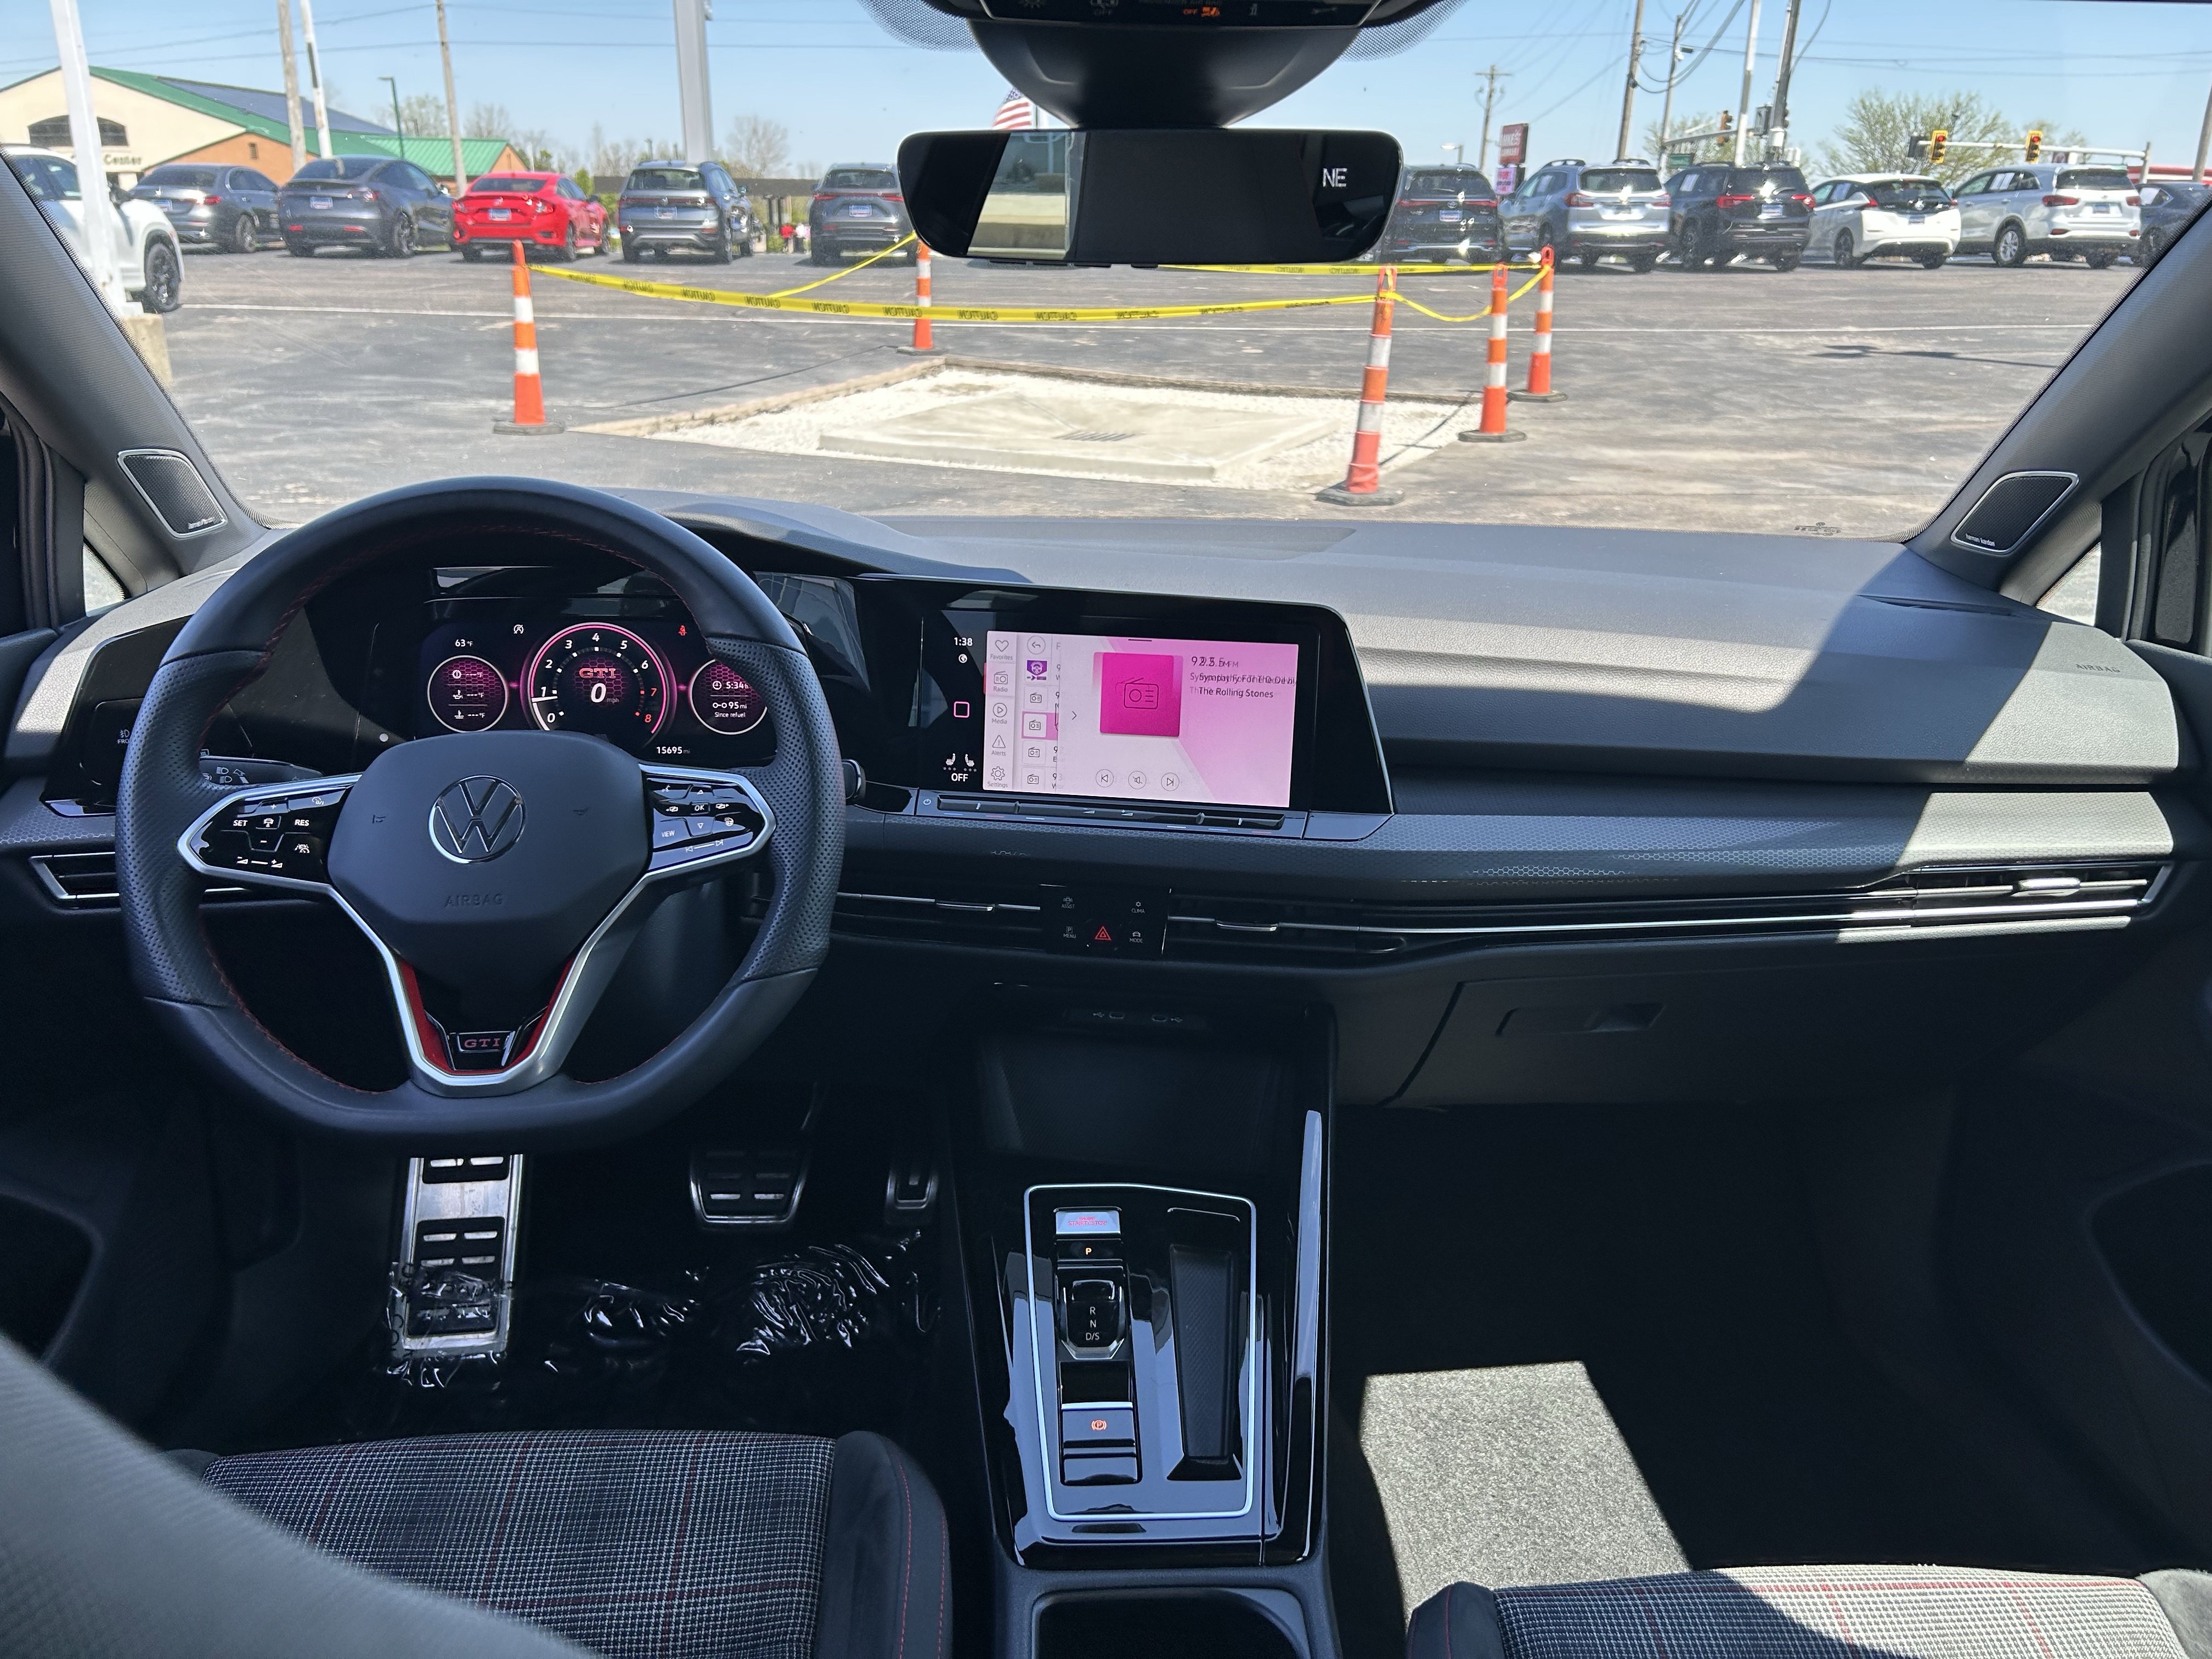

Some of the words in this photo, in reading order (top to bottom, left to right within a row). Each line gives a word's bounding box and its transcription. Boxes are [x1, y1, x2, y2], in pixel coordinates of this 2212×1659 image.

[1323, 168, 1347, 187] NE
[592, 633, 600, 642] 4
[953, 637, 973, 646] 1:38
[565, 640, 573, 649] 3
[620, 640, 628, 650] 5
[545, 659, 553, 669] 2
[641, 660, 649, 669] 6
[2074, 664, 2121, 673] AIRBAG
[579, 668, 616, 679] GTI
[541, 686, 547, 697] 1
[590, 683, 607, 703] 0
[650, 688, 657, 697] 7
[1199, 687, 1214, 695] The
[1216, 688, 1243, 698] Rolling
[1245, 689, 1273, 698] Stones
[547, 713, 555, 723] 0
[645, 714, 652, 723] 8
[951, 772, 969, 782] OFF
[444, 893, 505, 908] AIRBAG
[464, 1038, 501, 1048] GTI
[1090, 1306, 1096, 1315] R
[1090, 1319, 1097, 1328] N
[1085, 1332, 1100, 1341] D/S
